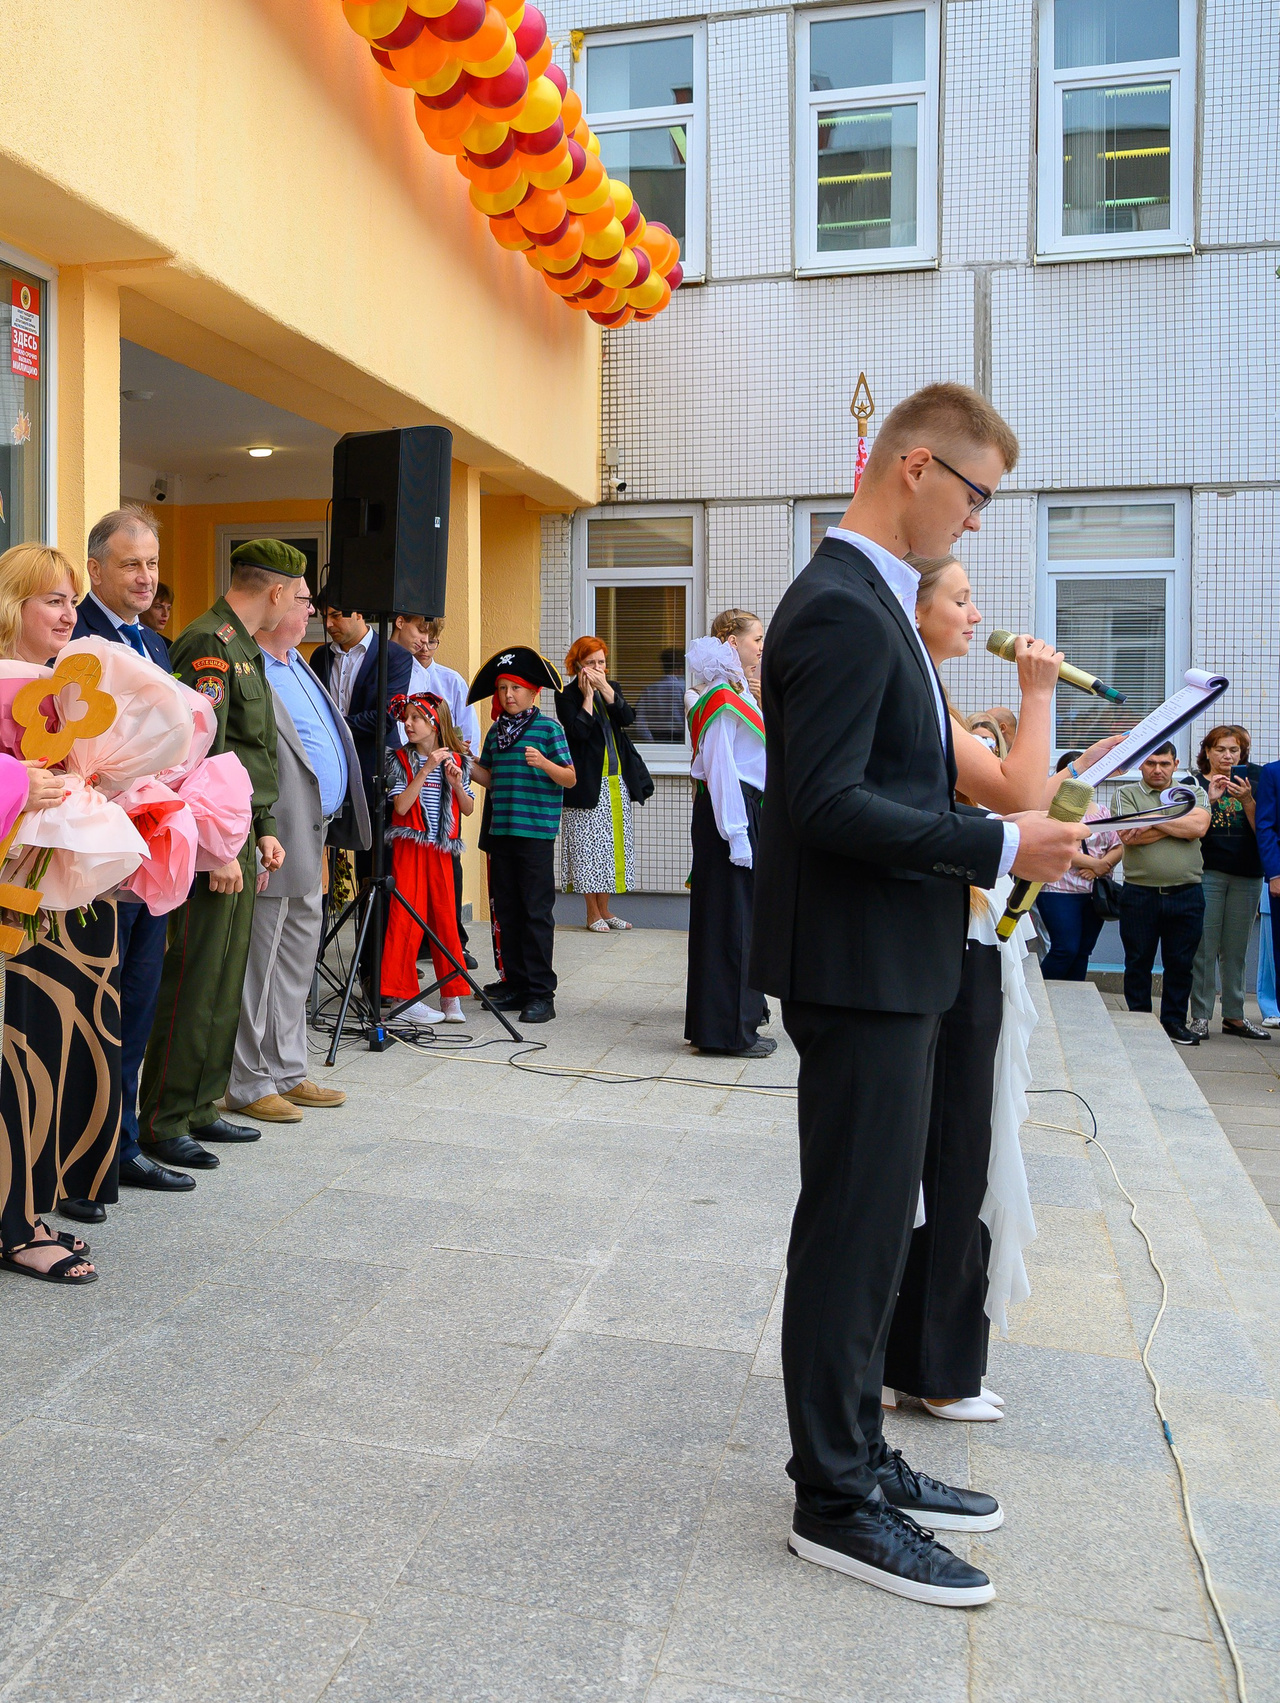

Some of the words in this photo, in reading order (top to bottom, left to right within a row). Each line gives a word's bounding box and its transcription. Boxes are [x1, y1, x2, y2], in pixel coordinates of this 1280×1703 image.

[13, 329, 38, 351] ЗДЕСЬ
[12, 360, 38, 376] МИЛИЦИЮ
[196, 660, 226, 669] СПЕЦНАЗ
